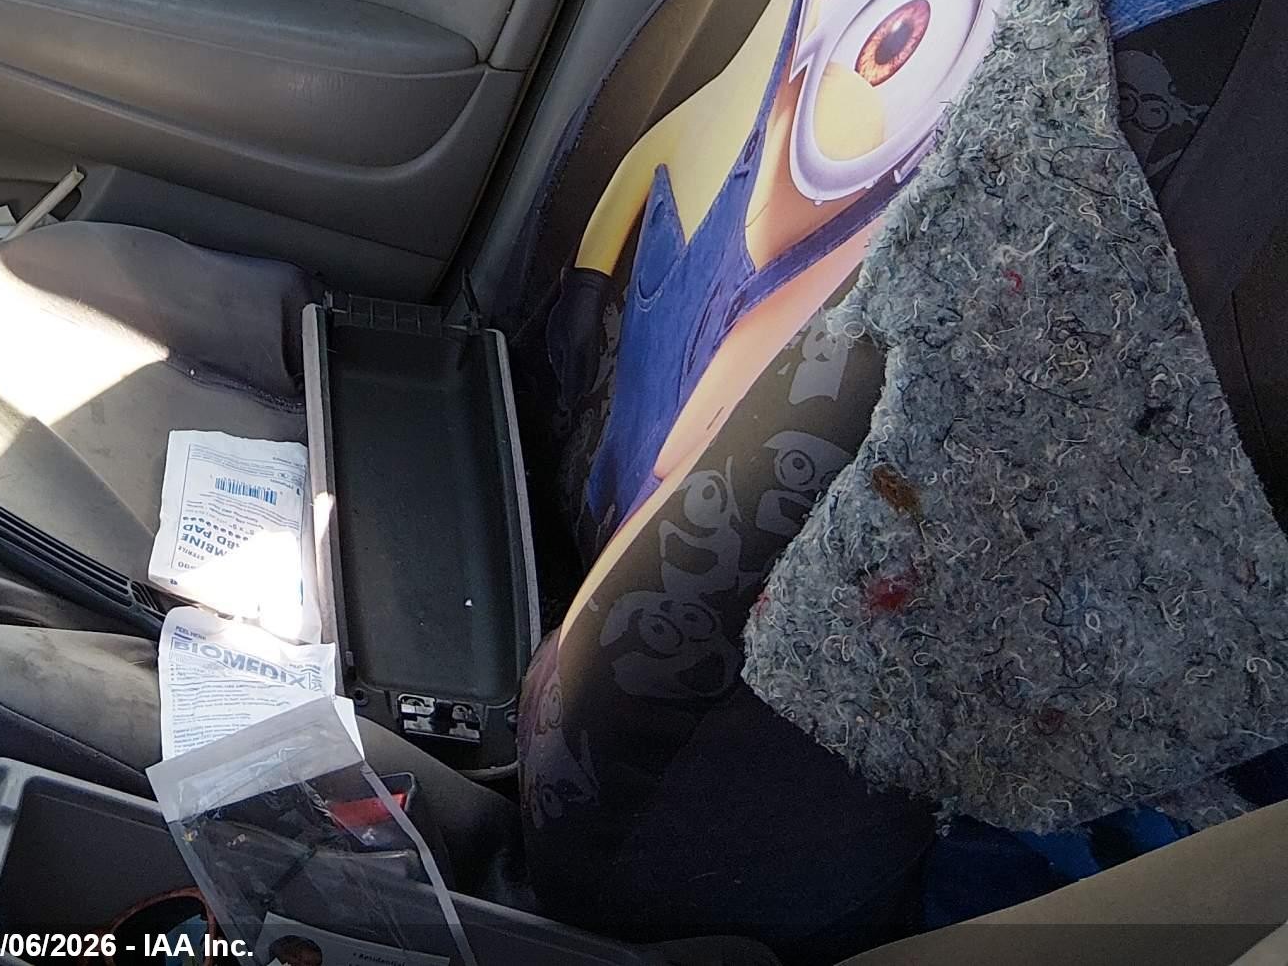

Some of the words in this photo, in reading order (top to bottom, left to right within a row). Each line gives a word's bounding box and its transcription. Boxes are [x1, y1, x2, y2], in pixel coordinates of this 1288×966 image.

[182, 523, 212, 540] PAD
[181, 533, 228, 557] MBINE
[173, 640, 307, 690] BIOMEDIX
